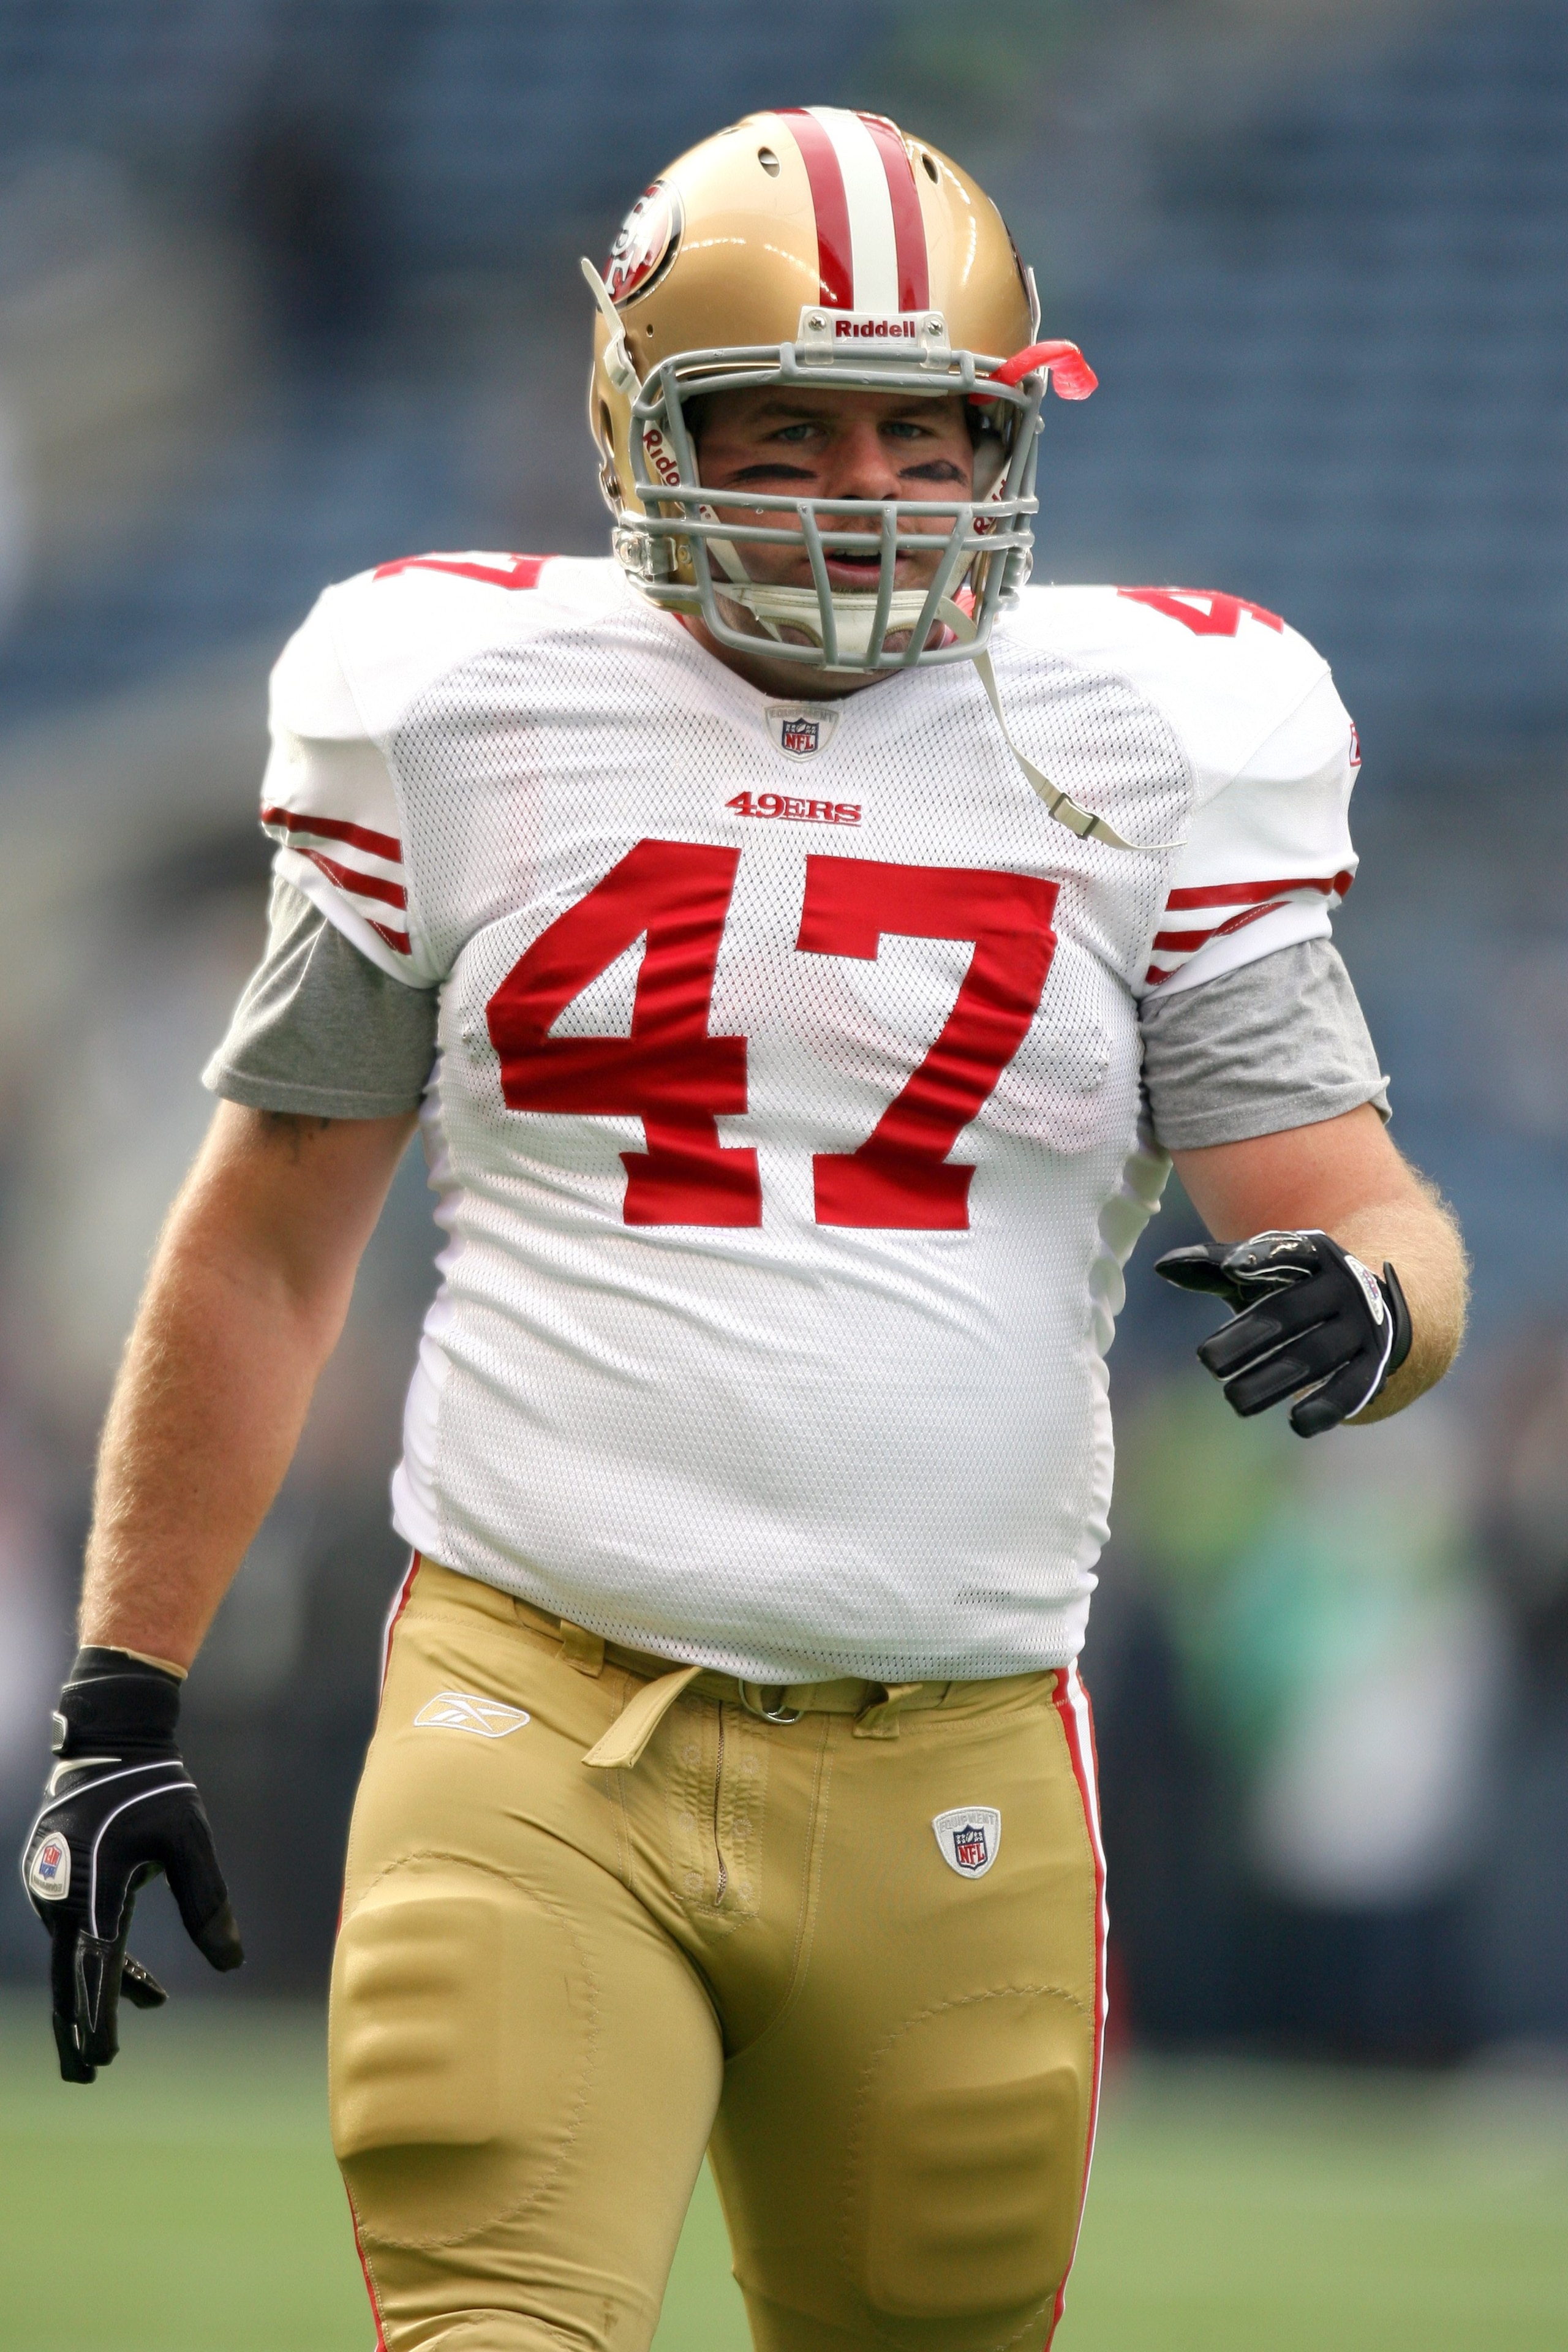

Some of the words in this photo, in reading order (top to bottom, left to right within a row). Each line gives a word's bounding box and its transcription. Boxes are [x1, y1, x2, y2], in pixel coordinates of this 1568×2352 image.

[836, 320, 915, 337] Riddell
[786, 733, 814, 751] NFL
[725, 791, 862, 827] 49ERS
[486, 838, 1061, 1230] 47
[940, 1812, 995, 1831] EQUIPMENT
[959, 1844, 986, 1865] NFL
